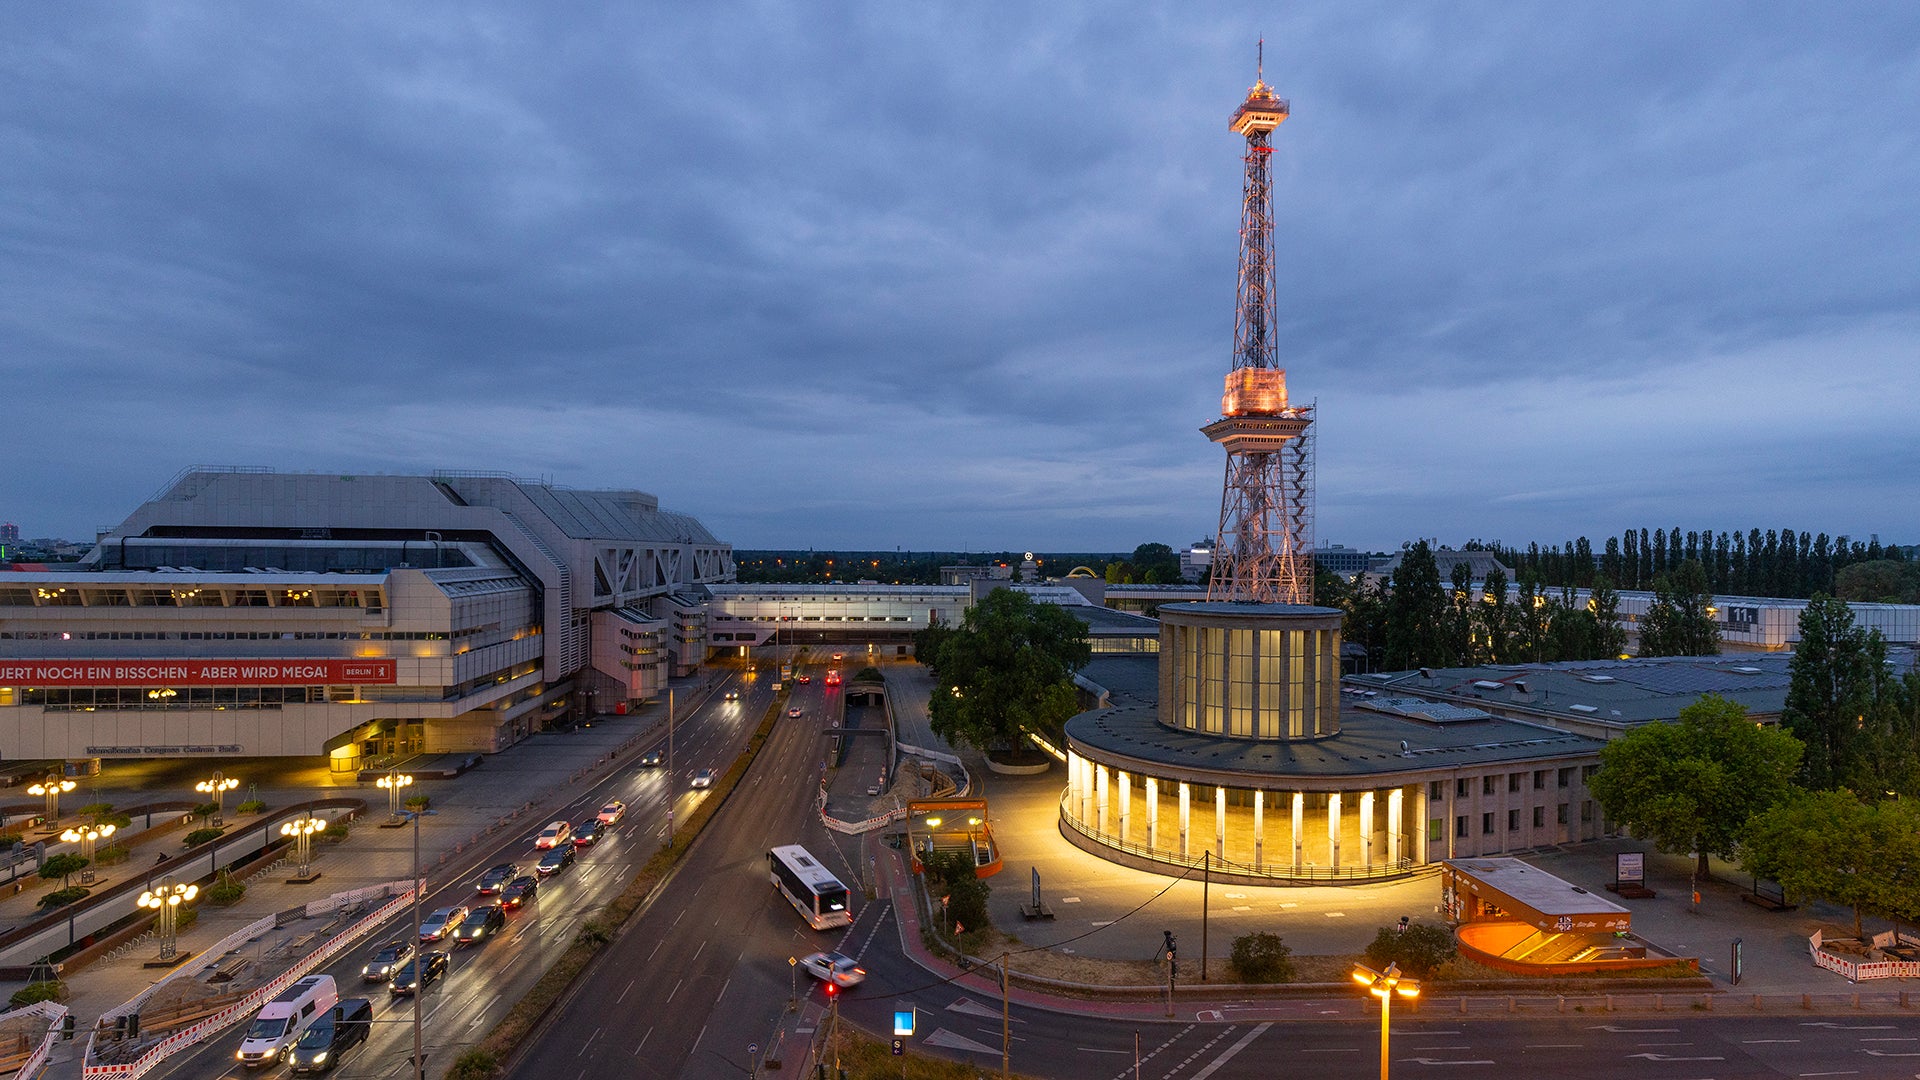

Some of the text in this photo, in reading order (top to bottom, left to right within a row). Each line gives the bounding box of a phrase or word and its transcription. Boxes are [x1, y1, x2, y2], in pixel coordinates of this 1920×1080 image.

[36, 667, 83, 679] NOCH
[87, 667, 111, 679] EIN
[115, 667, 187, 679] BISSCHEN
[200, 667, 238, 679] ABER
[241, 667, 279, 679] WIRD
[282, 666, 328, 679] MEGA!
[346, 668, 372, 676] BERLIN
[893, 1040, 901, 1049] S
